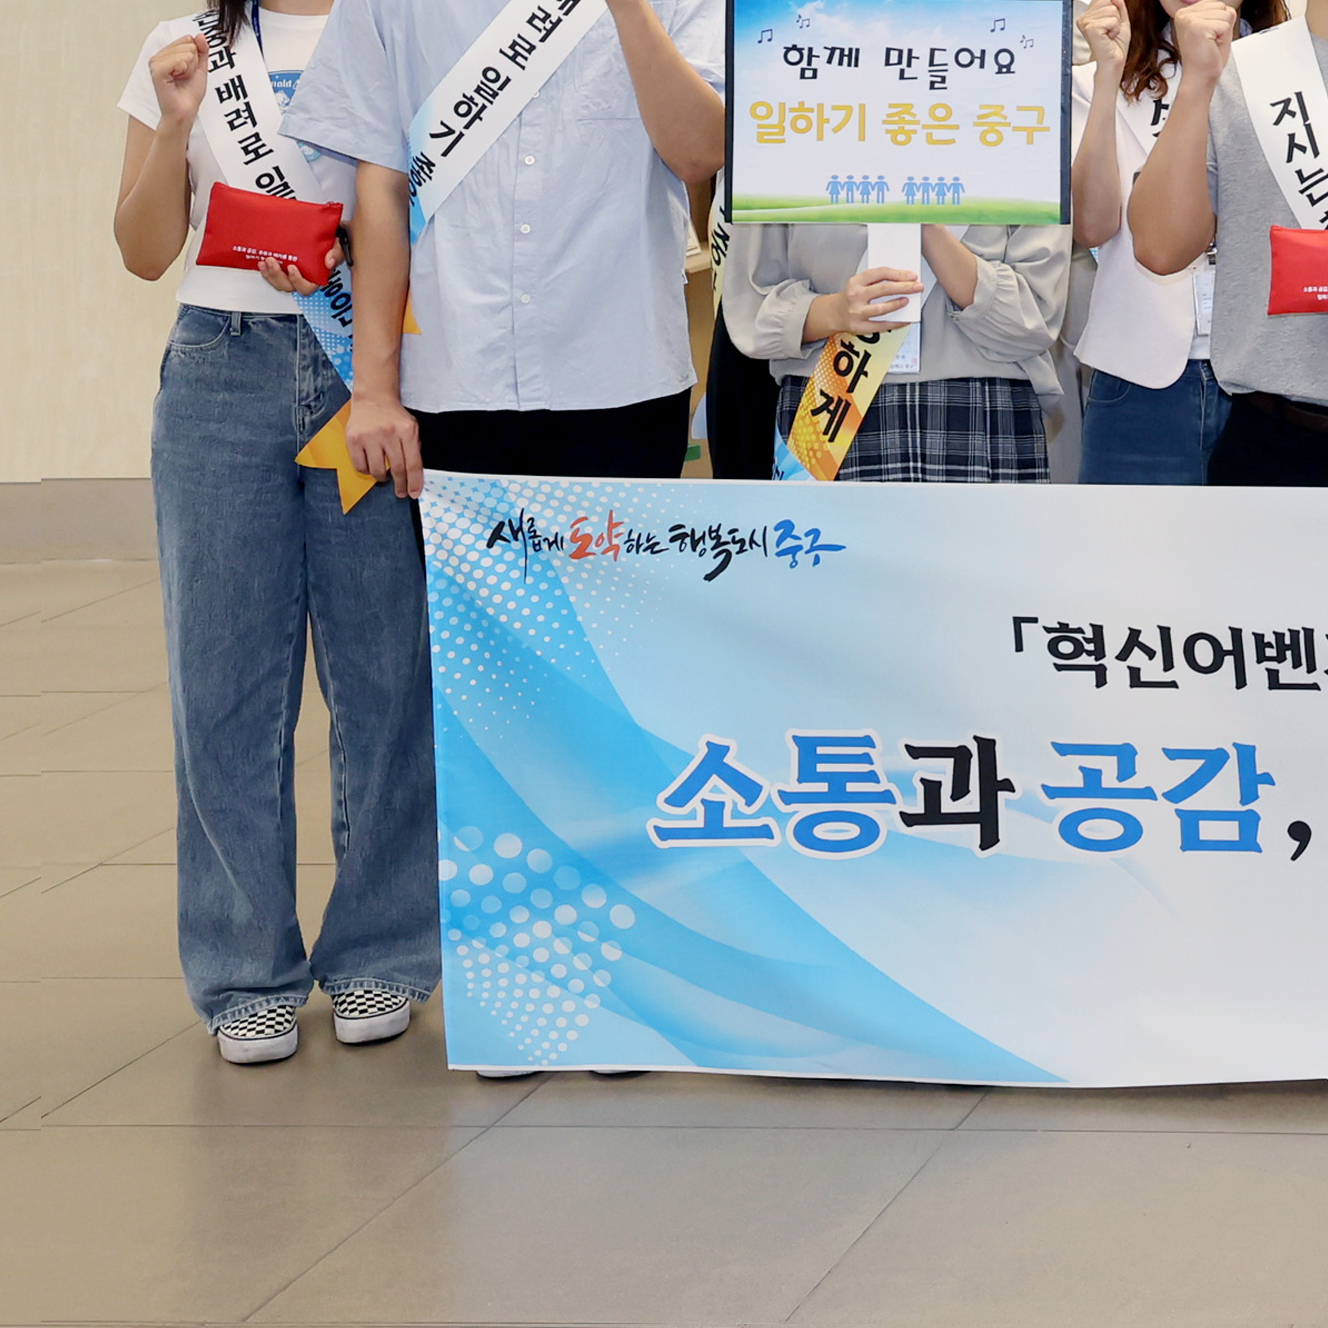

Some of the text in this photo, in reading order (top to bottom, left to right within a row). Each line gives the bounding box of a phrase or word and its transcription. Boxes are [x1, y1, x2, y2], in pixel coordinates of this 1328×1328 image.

[783, 44, 1015, 91] 함께 만들어요
[215, 74, 274, 166] 배려로
[429, 66, 512, 157] 일하기
[750, 101, 1050, 147] 일하기 좋은 중구
[486, 507, 846, 583] 새롭게 도약하는 행복도시 중구
[652, 734, 1016, 856] 소통과
[1041, 742, 1312, 862] 공감,
